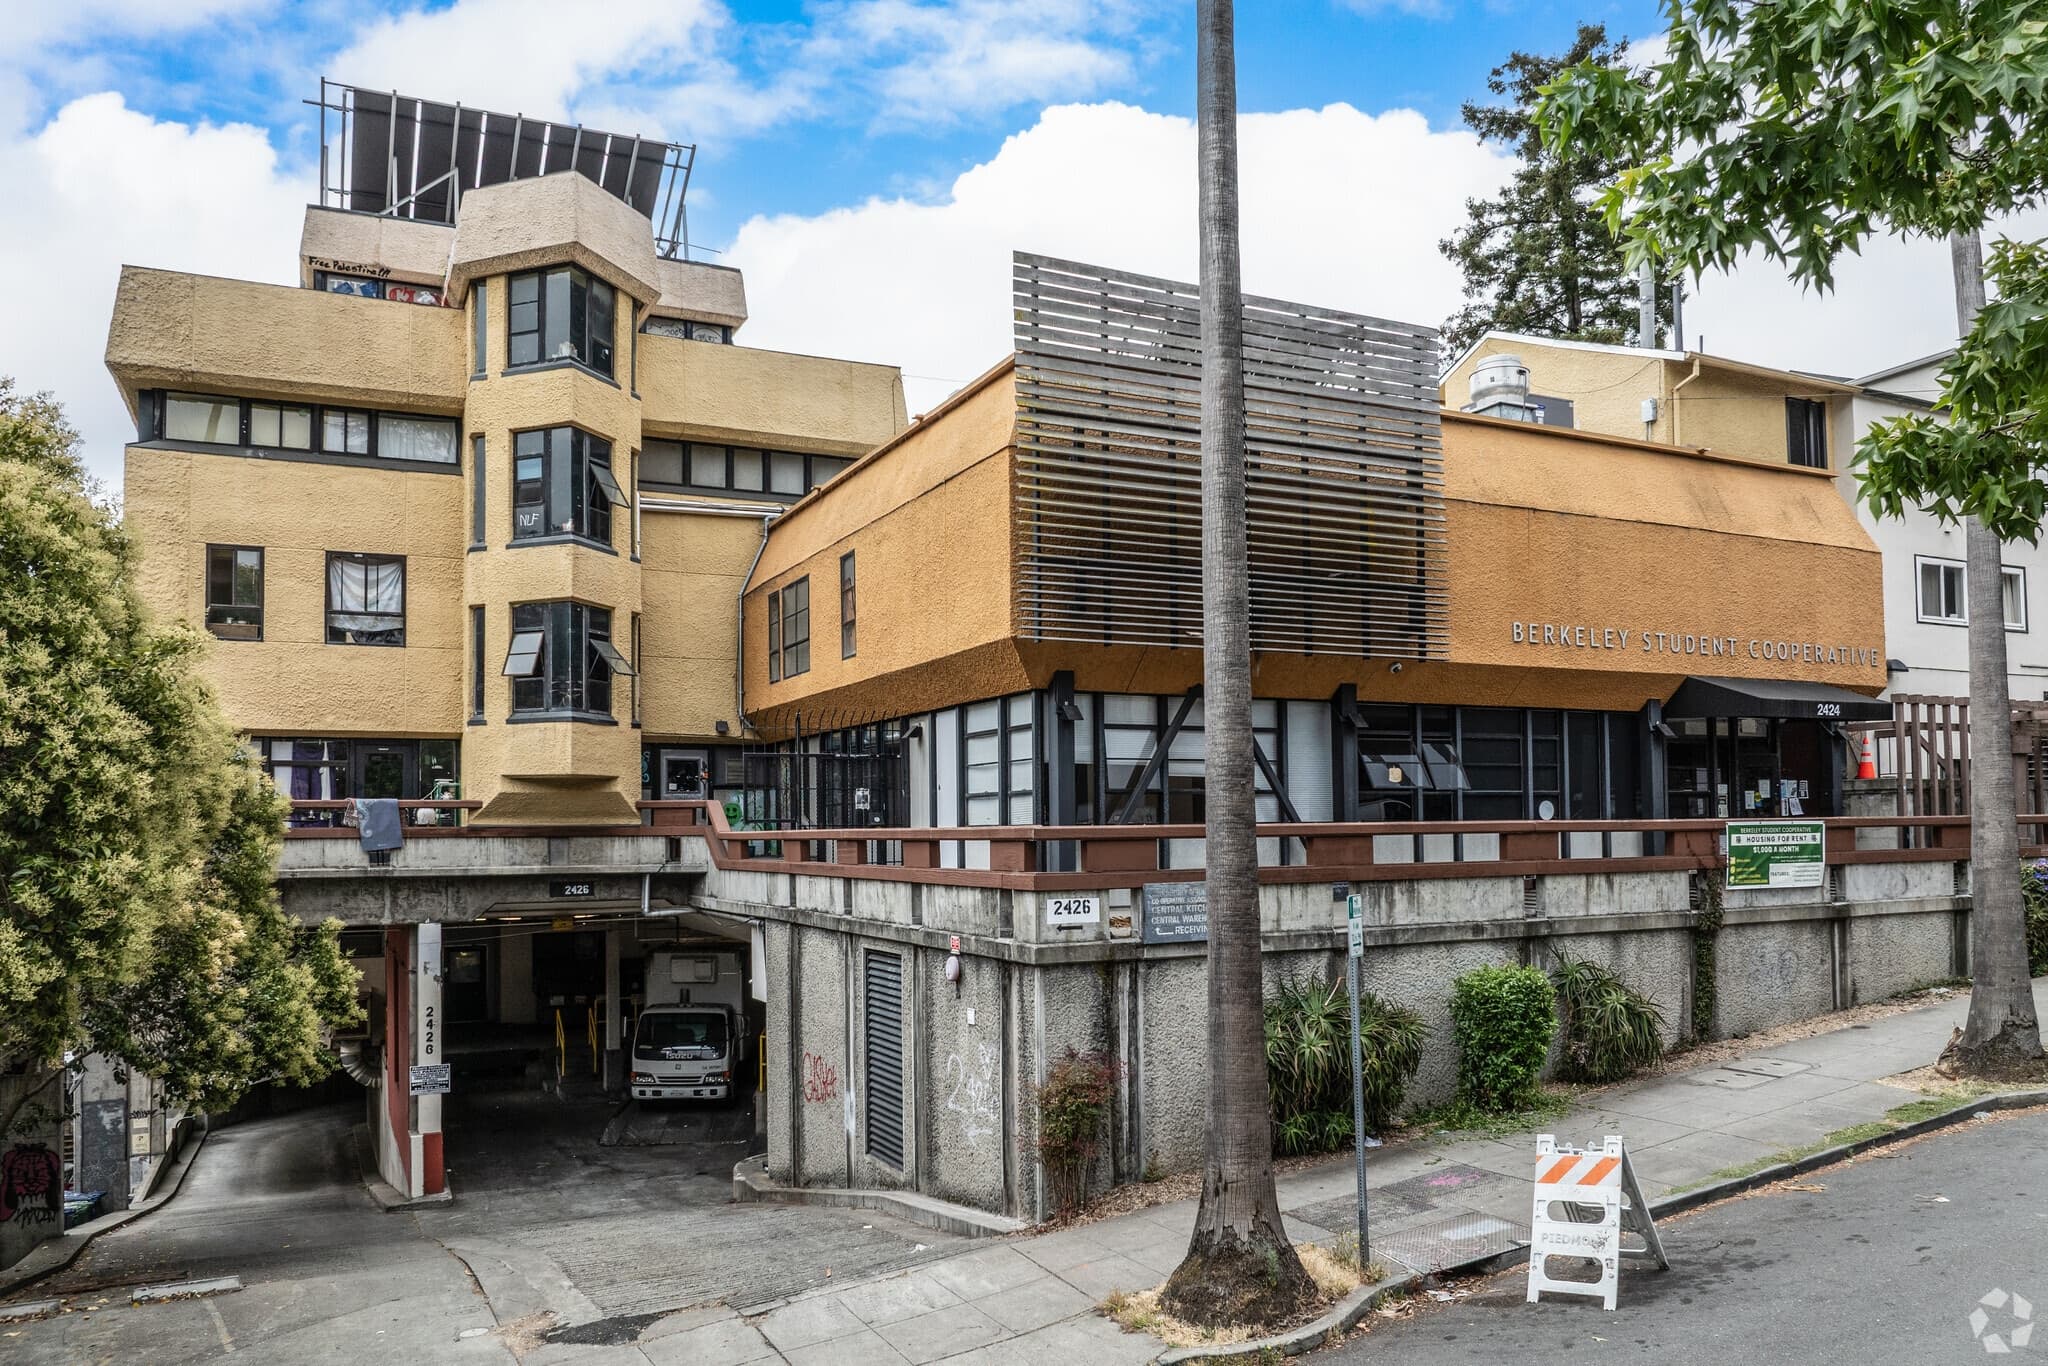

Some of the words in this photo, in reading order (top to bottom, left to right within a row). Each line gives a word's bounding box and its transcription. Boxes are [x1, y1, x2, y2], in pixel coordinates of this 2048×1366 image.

[309, 256, 331, 269] Free
[1512, 621, 1629, 649] BERKELEY
[1642, 631, 1737, 656] STUDENT
[1749, 639, 1878, 667] COOPERATIVE
[1816, 703, 1841, 716] 2424
[564, 884, 590, 895] 2426
[1053, 899, 1091, 915] 2426
[1151, 905, 1184, 914] CENTRAL
[1151, 915, 1180, 925] CENTRAL
[1175, 925, 1208, 935] RECEIVIN
[425, 1006, 434, 1055] 2426
